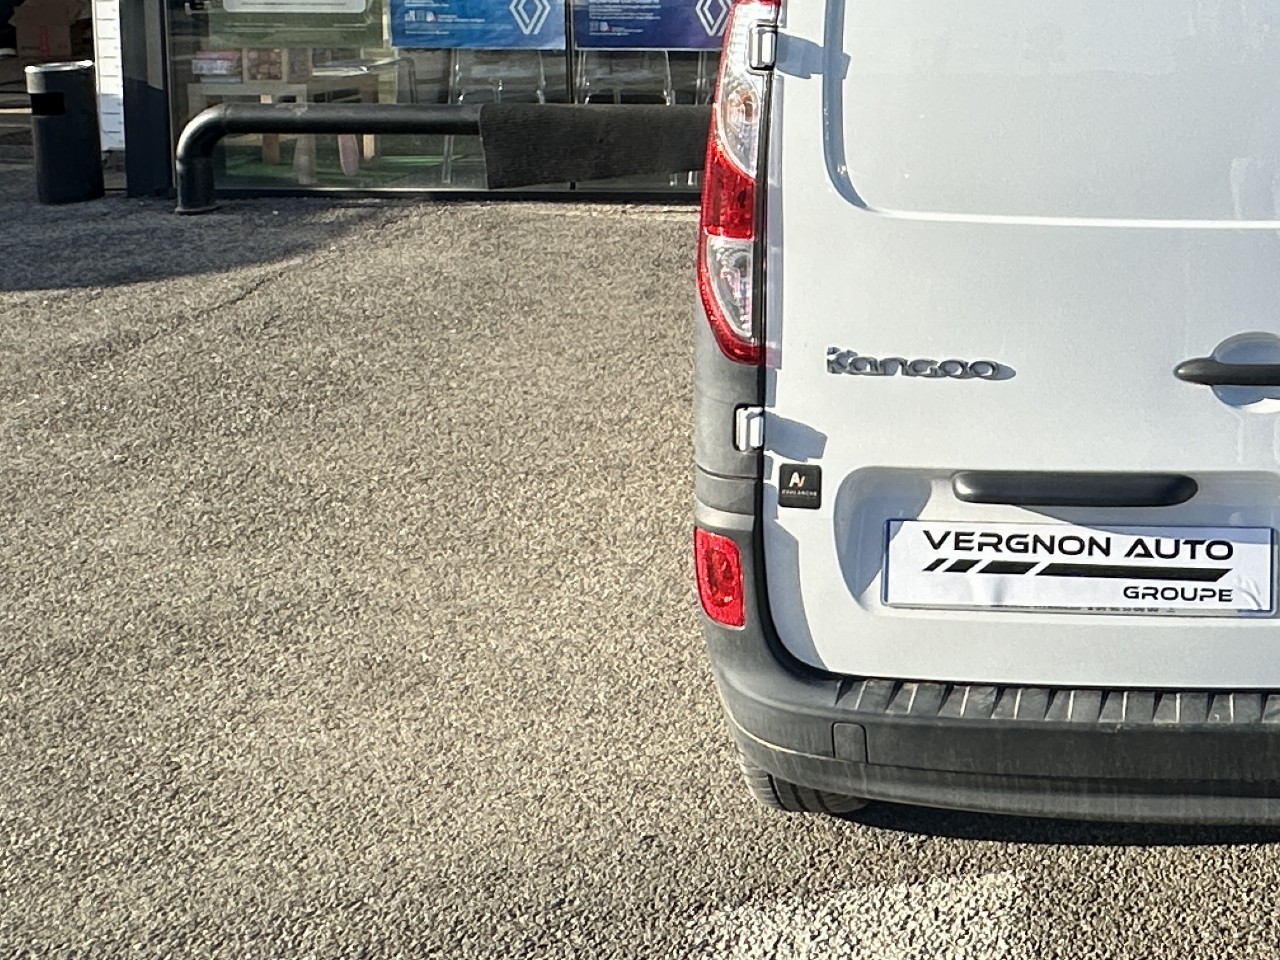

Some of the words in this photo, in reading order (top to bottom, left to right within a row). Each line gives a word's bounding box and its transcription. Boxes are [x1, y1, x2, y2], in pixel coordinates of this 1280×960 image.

[826, 346, 999, 380] Kangoo
[922, 530, 1111, 558] VERGNON
[1124, 536, 1234, 561] AUTO
[1123, 585, 1234, 603] GROUPE
